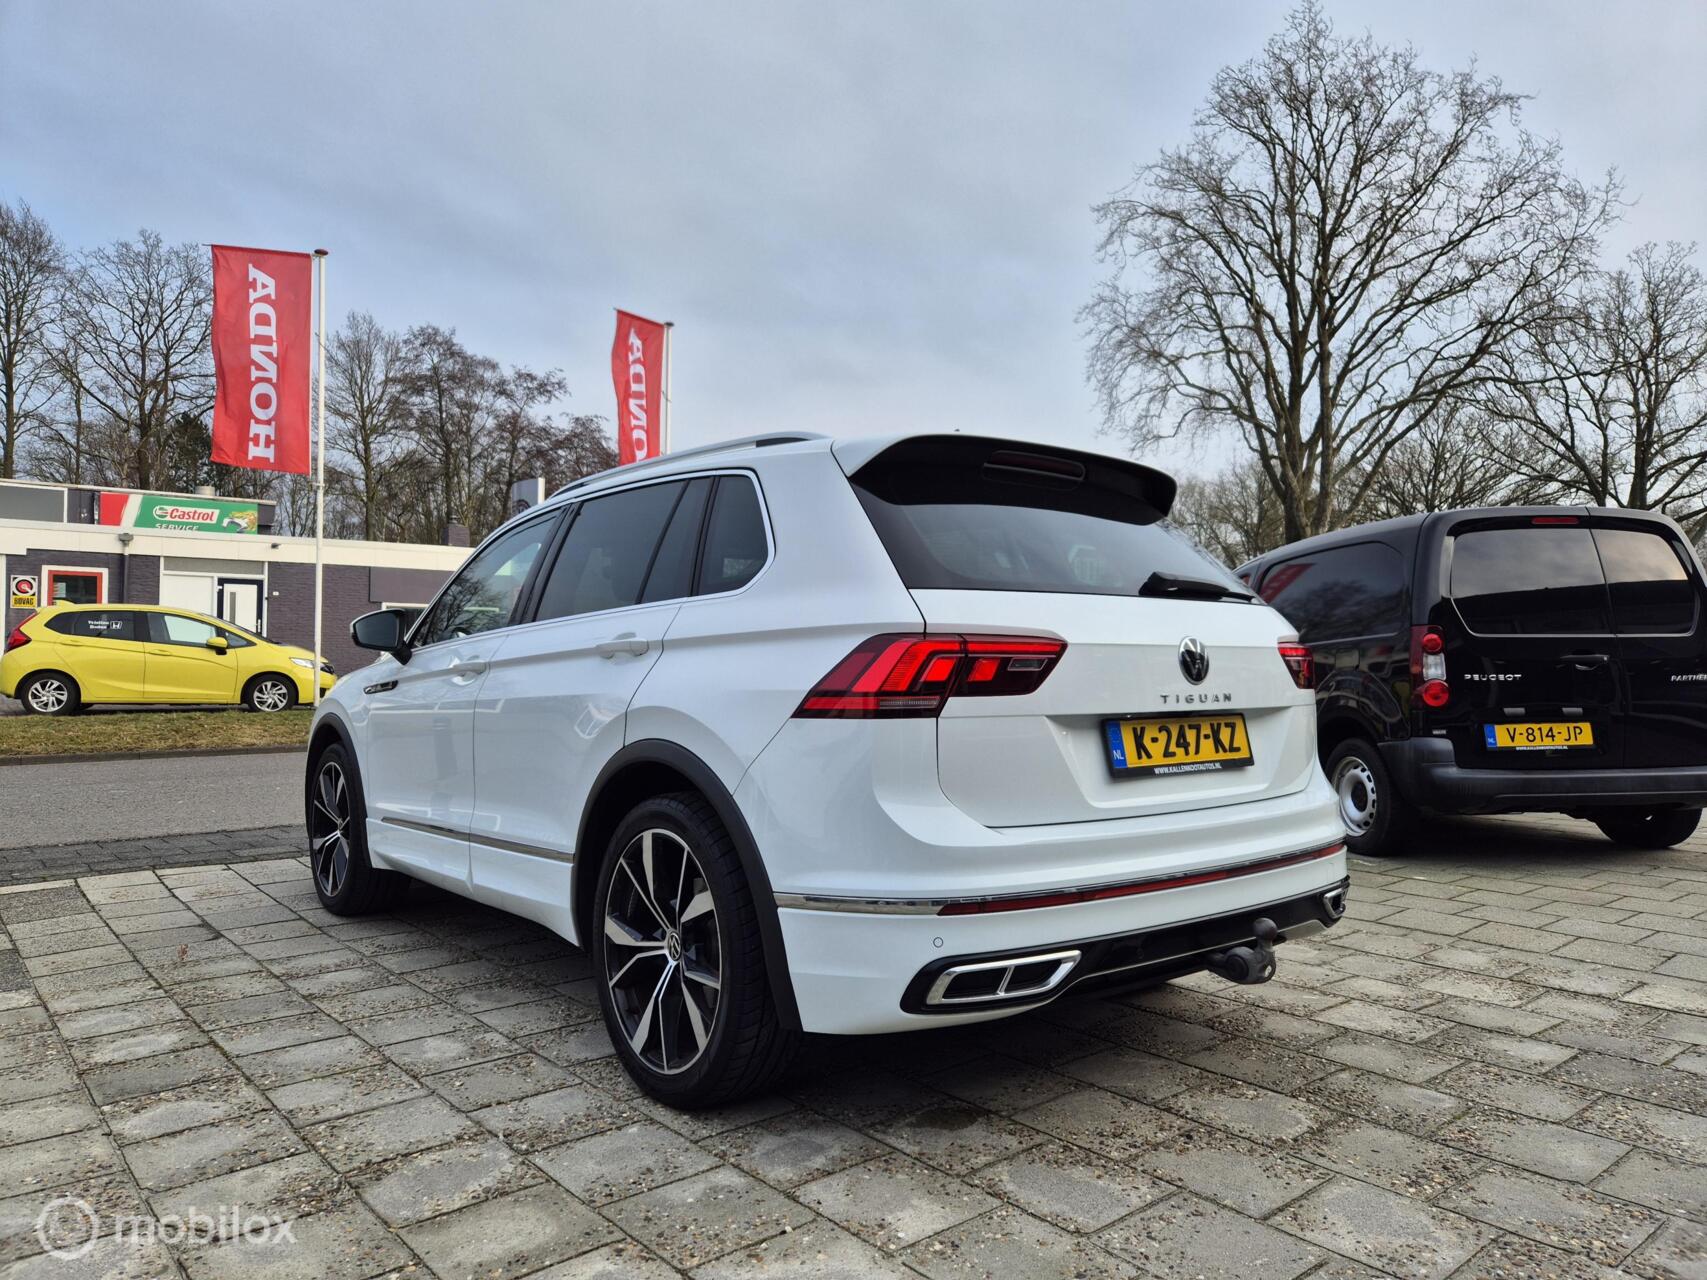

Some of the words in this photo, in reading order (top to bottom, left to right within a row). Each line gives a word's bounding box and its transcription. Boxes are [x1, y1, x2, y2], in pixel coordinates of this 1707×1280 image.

[169, 507, 215, 522] Castrol
[1160, 692, 1232, 704] TIGUAN
[1132, 721, 1242, 761] K-247-KZ
[1506, 726, 1583, 743] V-814-JP
[1113, 749, 1125, 760] NL
